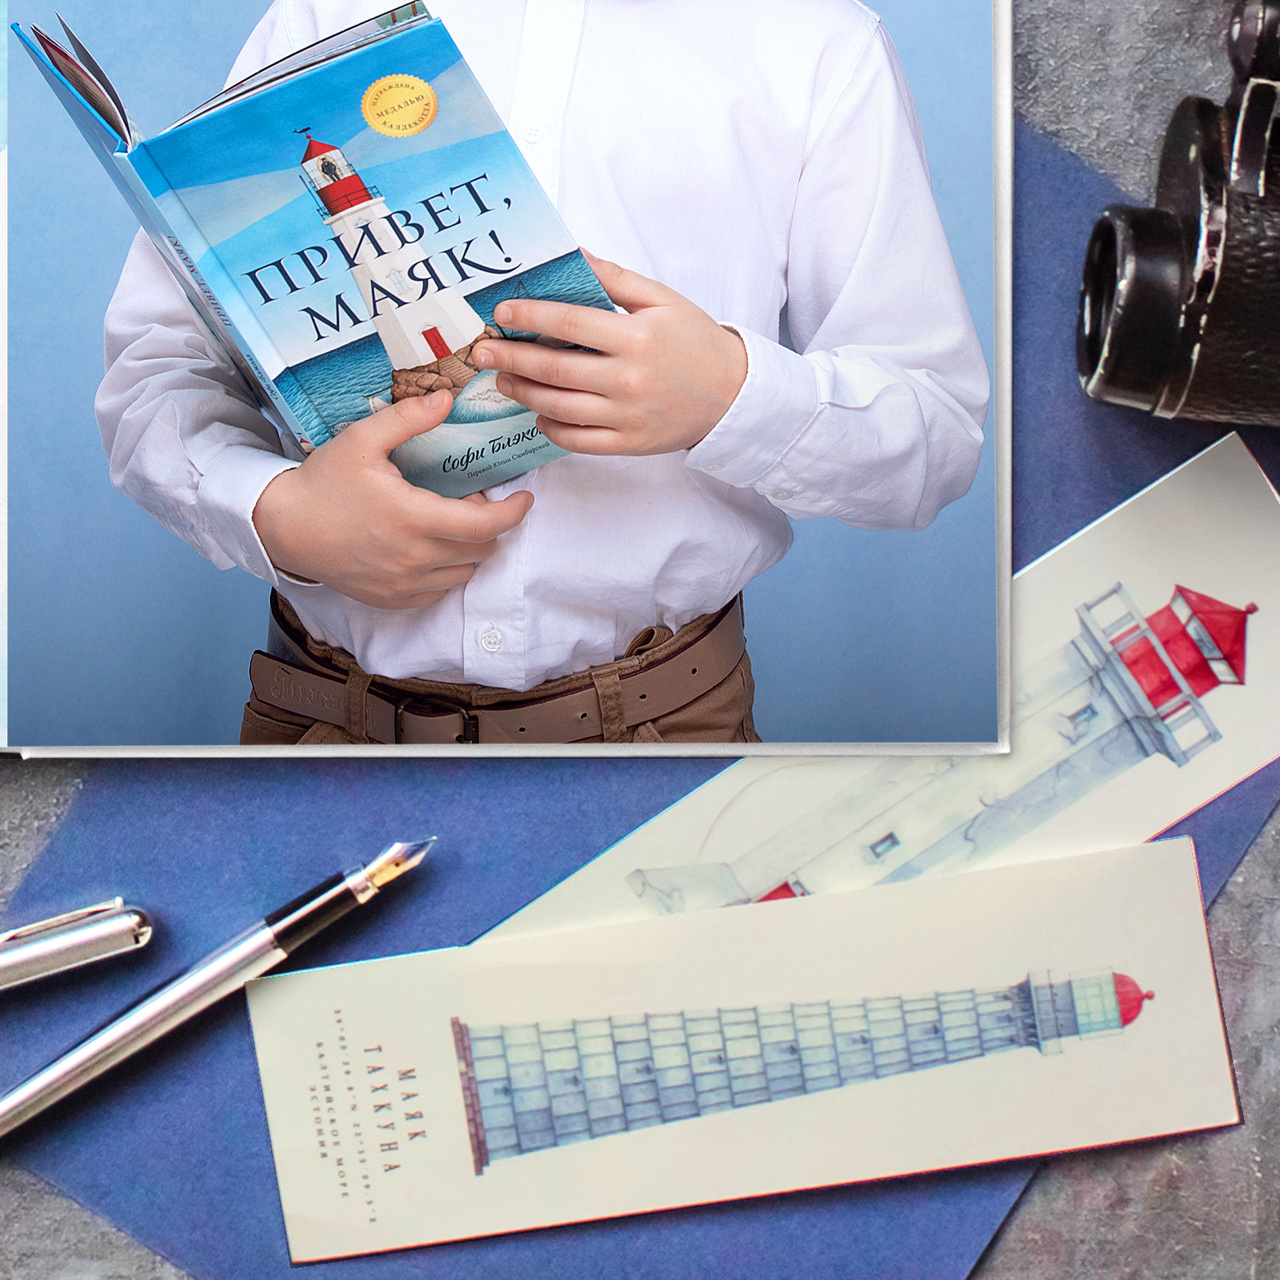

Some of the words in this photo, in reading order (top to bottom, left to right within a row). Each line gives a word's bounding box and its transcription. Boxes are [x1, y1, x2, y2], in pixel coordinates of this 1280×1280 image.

[376, 94, 424, 119] МЕДАЛЬЮ
[382, 102, 430, 131] КАЛДЕКОТТА
[241, 173, 512, 306] ПРИВЕТ,
[298, 229, 522, 342] МАЯК!
[442, 447, 485, 472] Софи
[489, 425, 542, 453] Блэко
[467, 464, 493, 478] Перевод
[309, 1085, 328, 1159] ЭСТОНИЯ
[316, 1041, 341, 1147] БАЛТИЙСКОЕ
[335, 1157, 349, 1198] МОРЕ
[363, 1045, 401, 1173] ТАХКУНА
[397, 1067, 426, 1141] МАЯК
